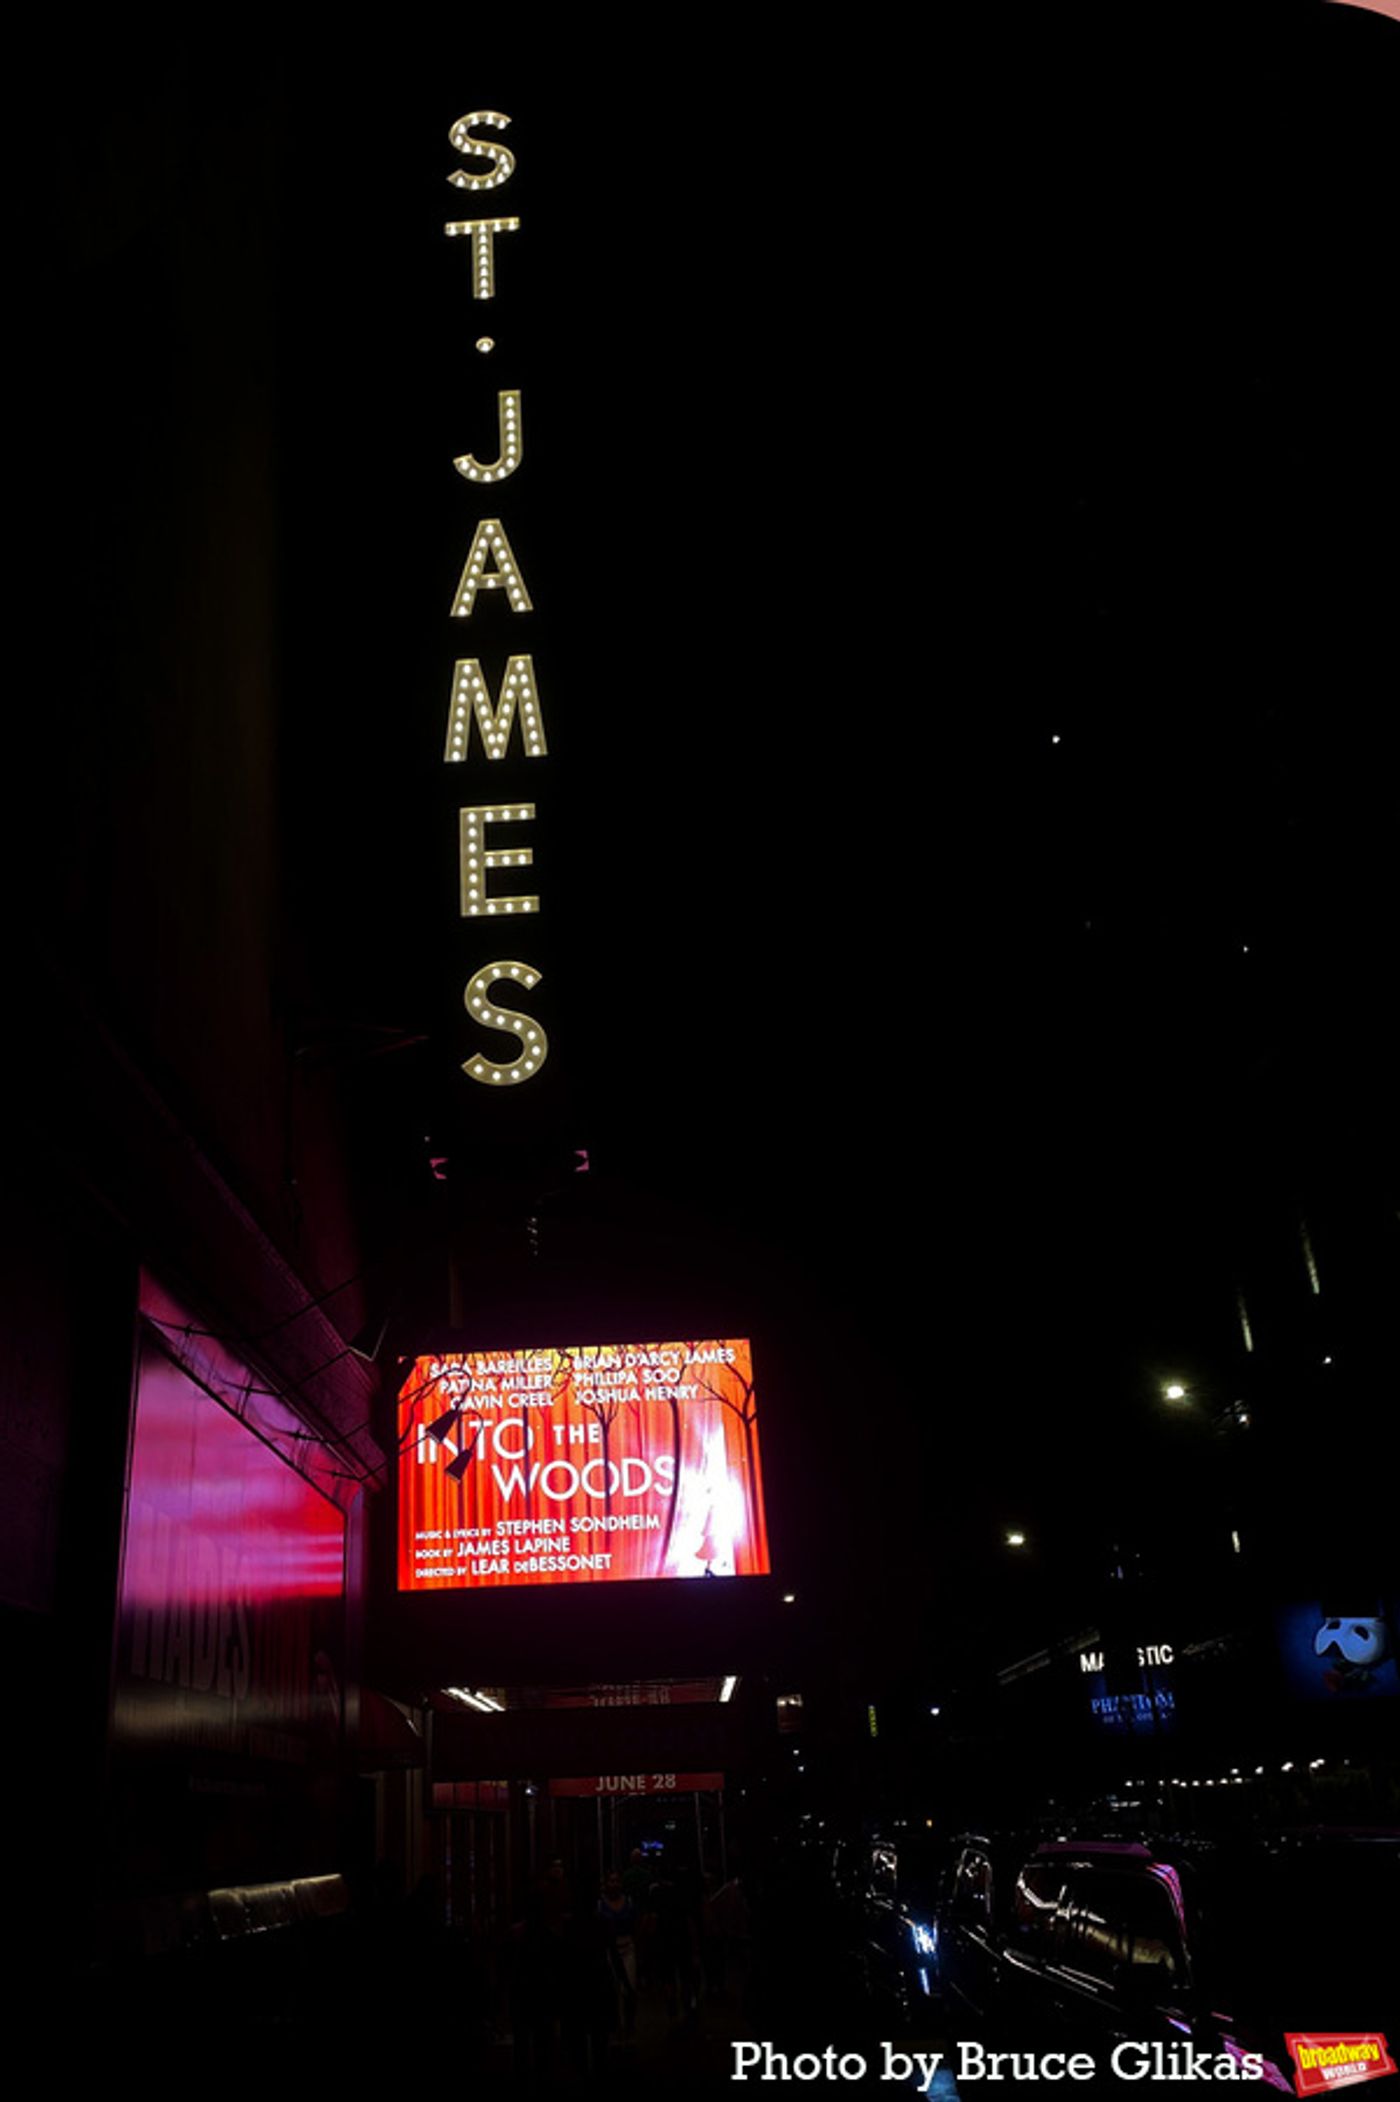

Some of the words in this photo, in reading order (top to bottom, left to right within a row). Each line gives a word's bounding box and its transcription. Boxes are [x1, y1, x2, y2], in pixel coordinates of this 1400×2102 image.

[444, 389, 548, 1086] JAMES
[476, 1358, 552, 1375] BAREILLES
[573, 1354, 622, 1370] BRIAN
[625, 1351, 681, 1367] D'ARCY
[684, 1347, 735, 1364] JAMES
[440, 1377, 496, 1394] PATNA
[502, 1375, 553, 1391] MILLER
[574, 1371, 638, 1386] PHILLIPA
[643, 1368, 681, 1384] SOO
[451, 1395, 503, 1410] GAVIN
[508, 1393, 554, 1408] CREEL
[575, 1388, 641, 1405] JOSHUA
[646, 1384, 699, 1401] HENRY
[553, 1423, 600, 1446] THE
[491, 1456, 675, 1503] WOODS
[496, 1519, 566, 1537] STEPHEN
[570, 1514, 661, 1533] SONDHEIM
[457, 1540, 510, 1557] JAMES
[514, 1536, 571, 1554] LAPINE
[471, 1558, 510, 1576] LEAR
[595, 1773, 647, 1792] JUNE
[652, 1773, 677, 1790] 28
